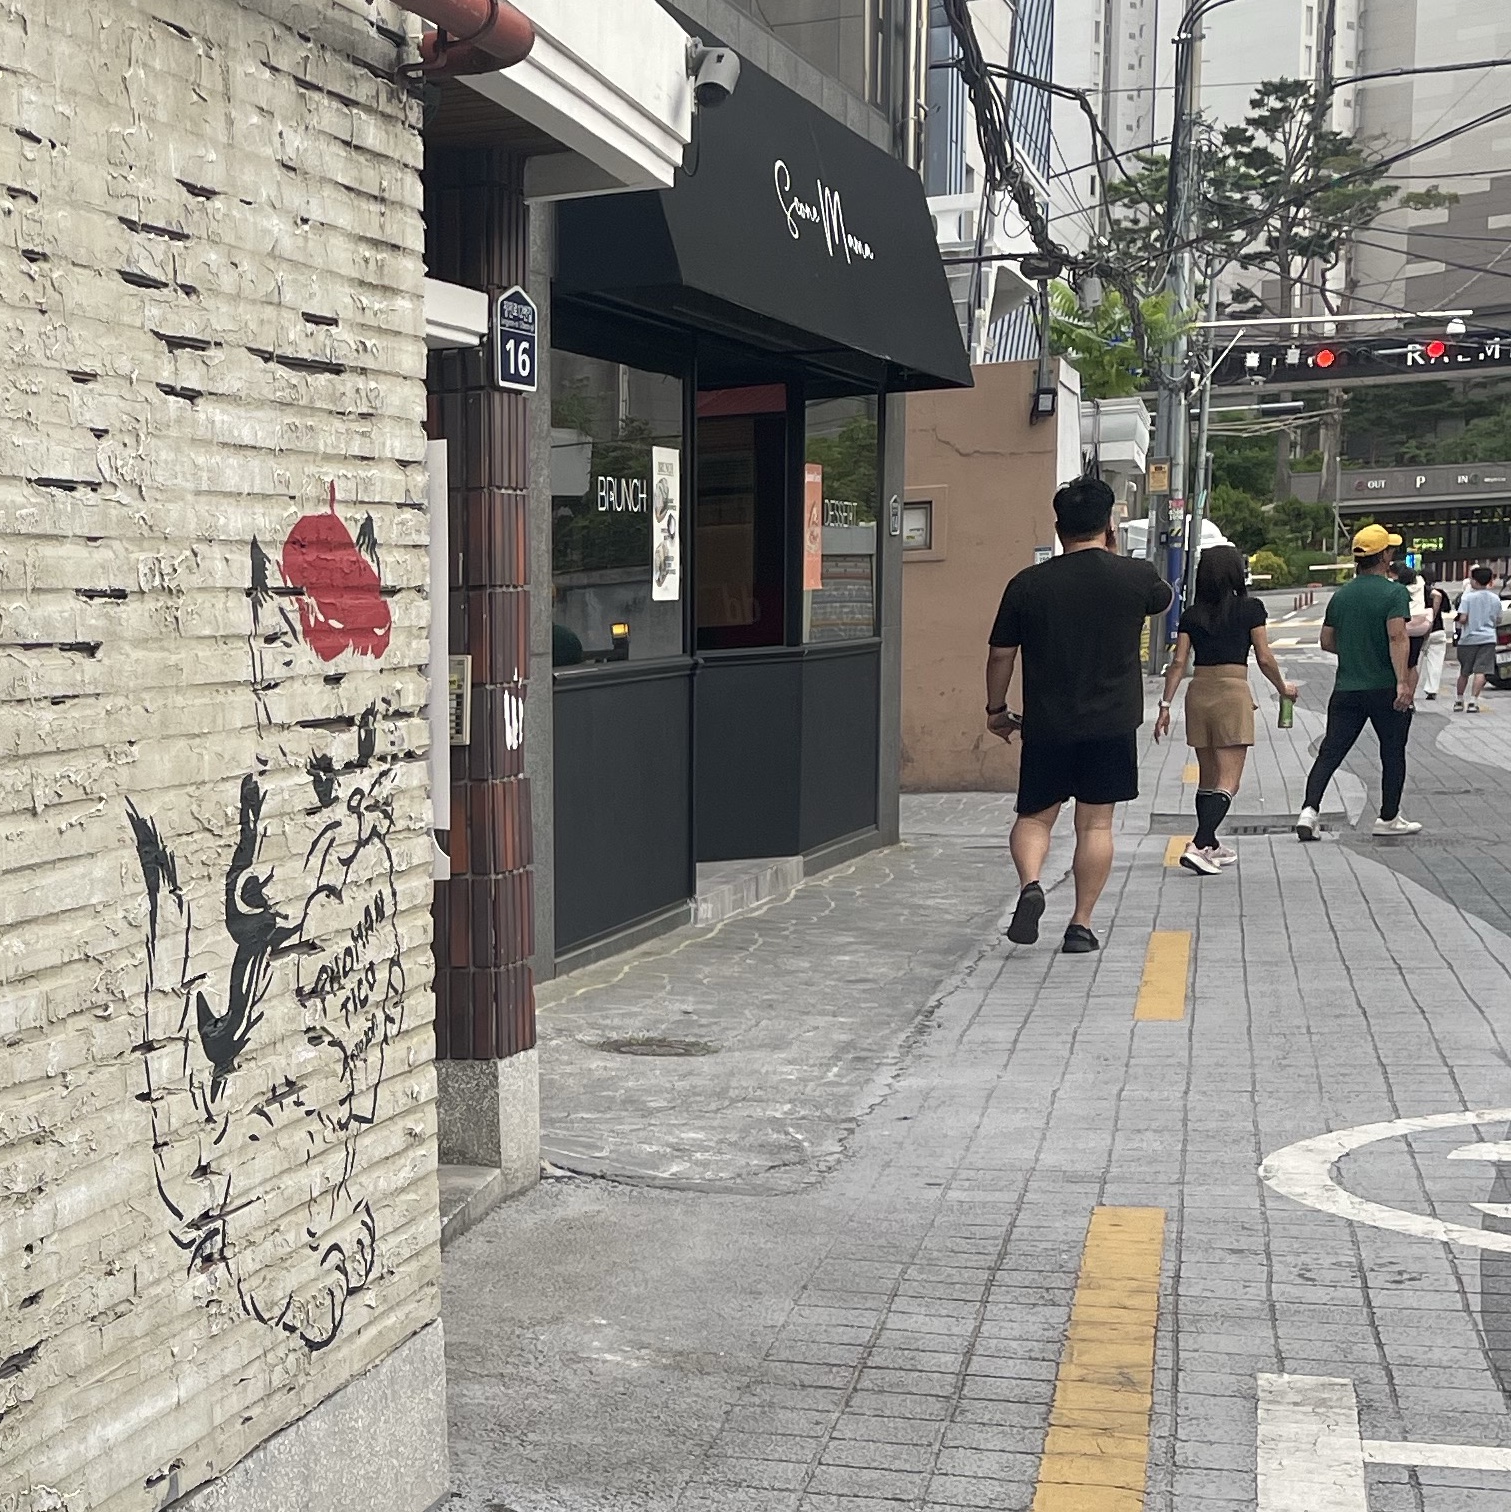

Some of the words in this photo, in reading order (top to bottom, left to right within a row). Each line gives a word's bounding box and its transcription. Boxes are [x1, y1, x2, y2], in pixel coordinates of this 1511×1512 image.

[774, 160, 821, 239] Scone
[816, 179, 874, 264] Mama
[505, 338, 531, 377] 16
[597, 475, 648, 513] BRUNCH
[1367, 479, 1387, 489] OUT
[1415, 475, 1426, 488] P
[1457, 475, 1469, 484] IN
[823, 498, 858, 528] DESSERT
